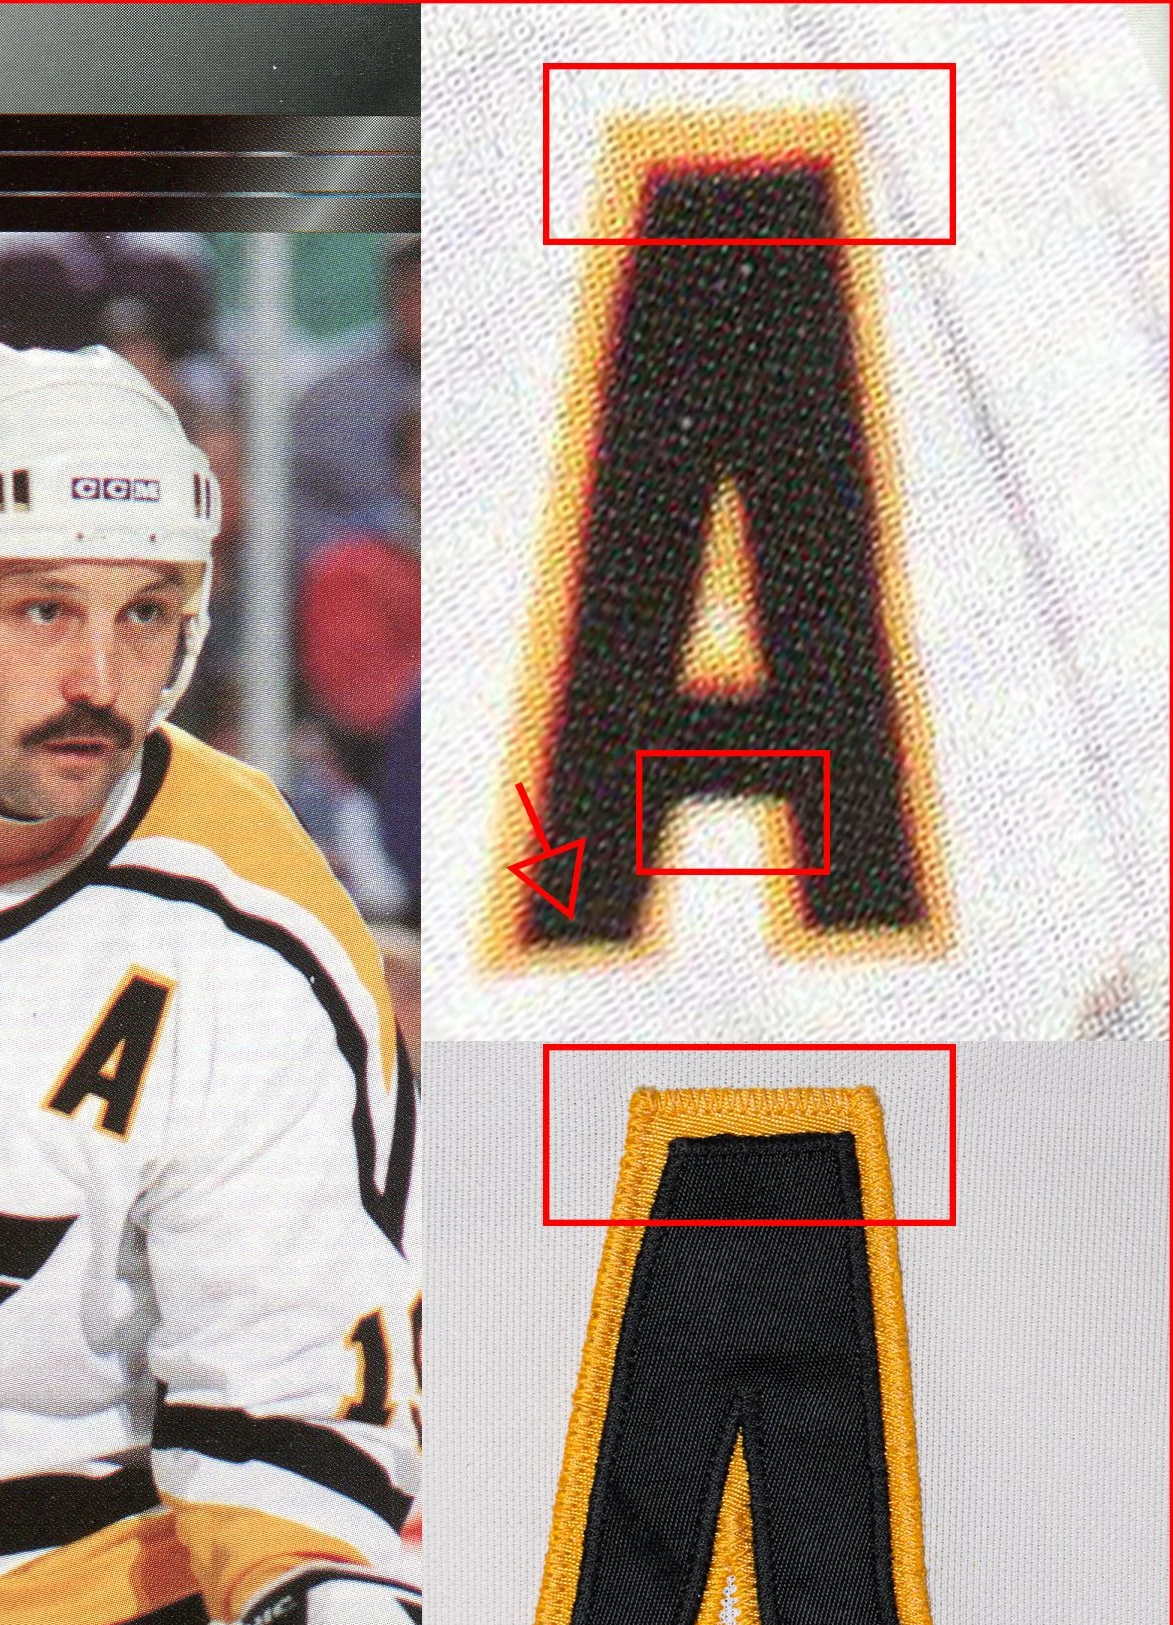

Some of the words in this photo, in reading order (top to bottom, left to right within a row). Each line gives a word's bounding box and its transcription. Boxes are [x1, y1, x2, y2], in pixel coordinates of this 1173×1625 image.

[71, 476, 160, 502] CCM
[478, 108, 956, 972] A
[39, 963, 178, 1143] A
